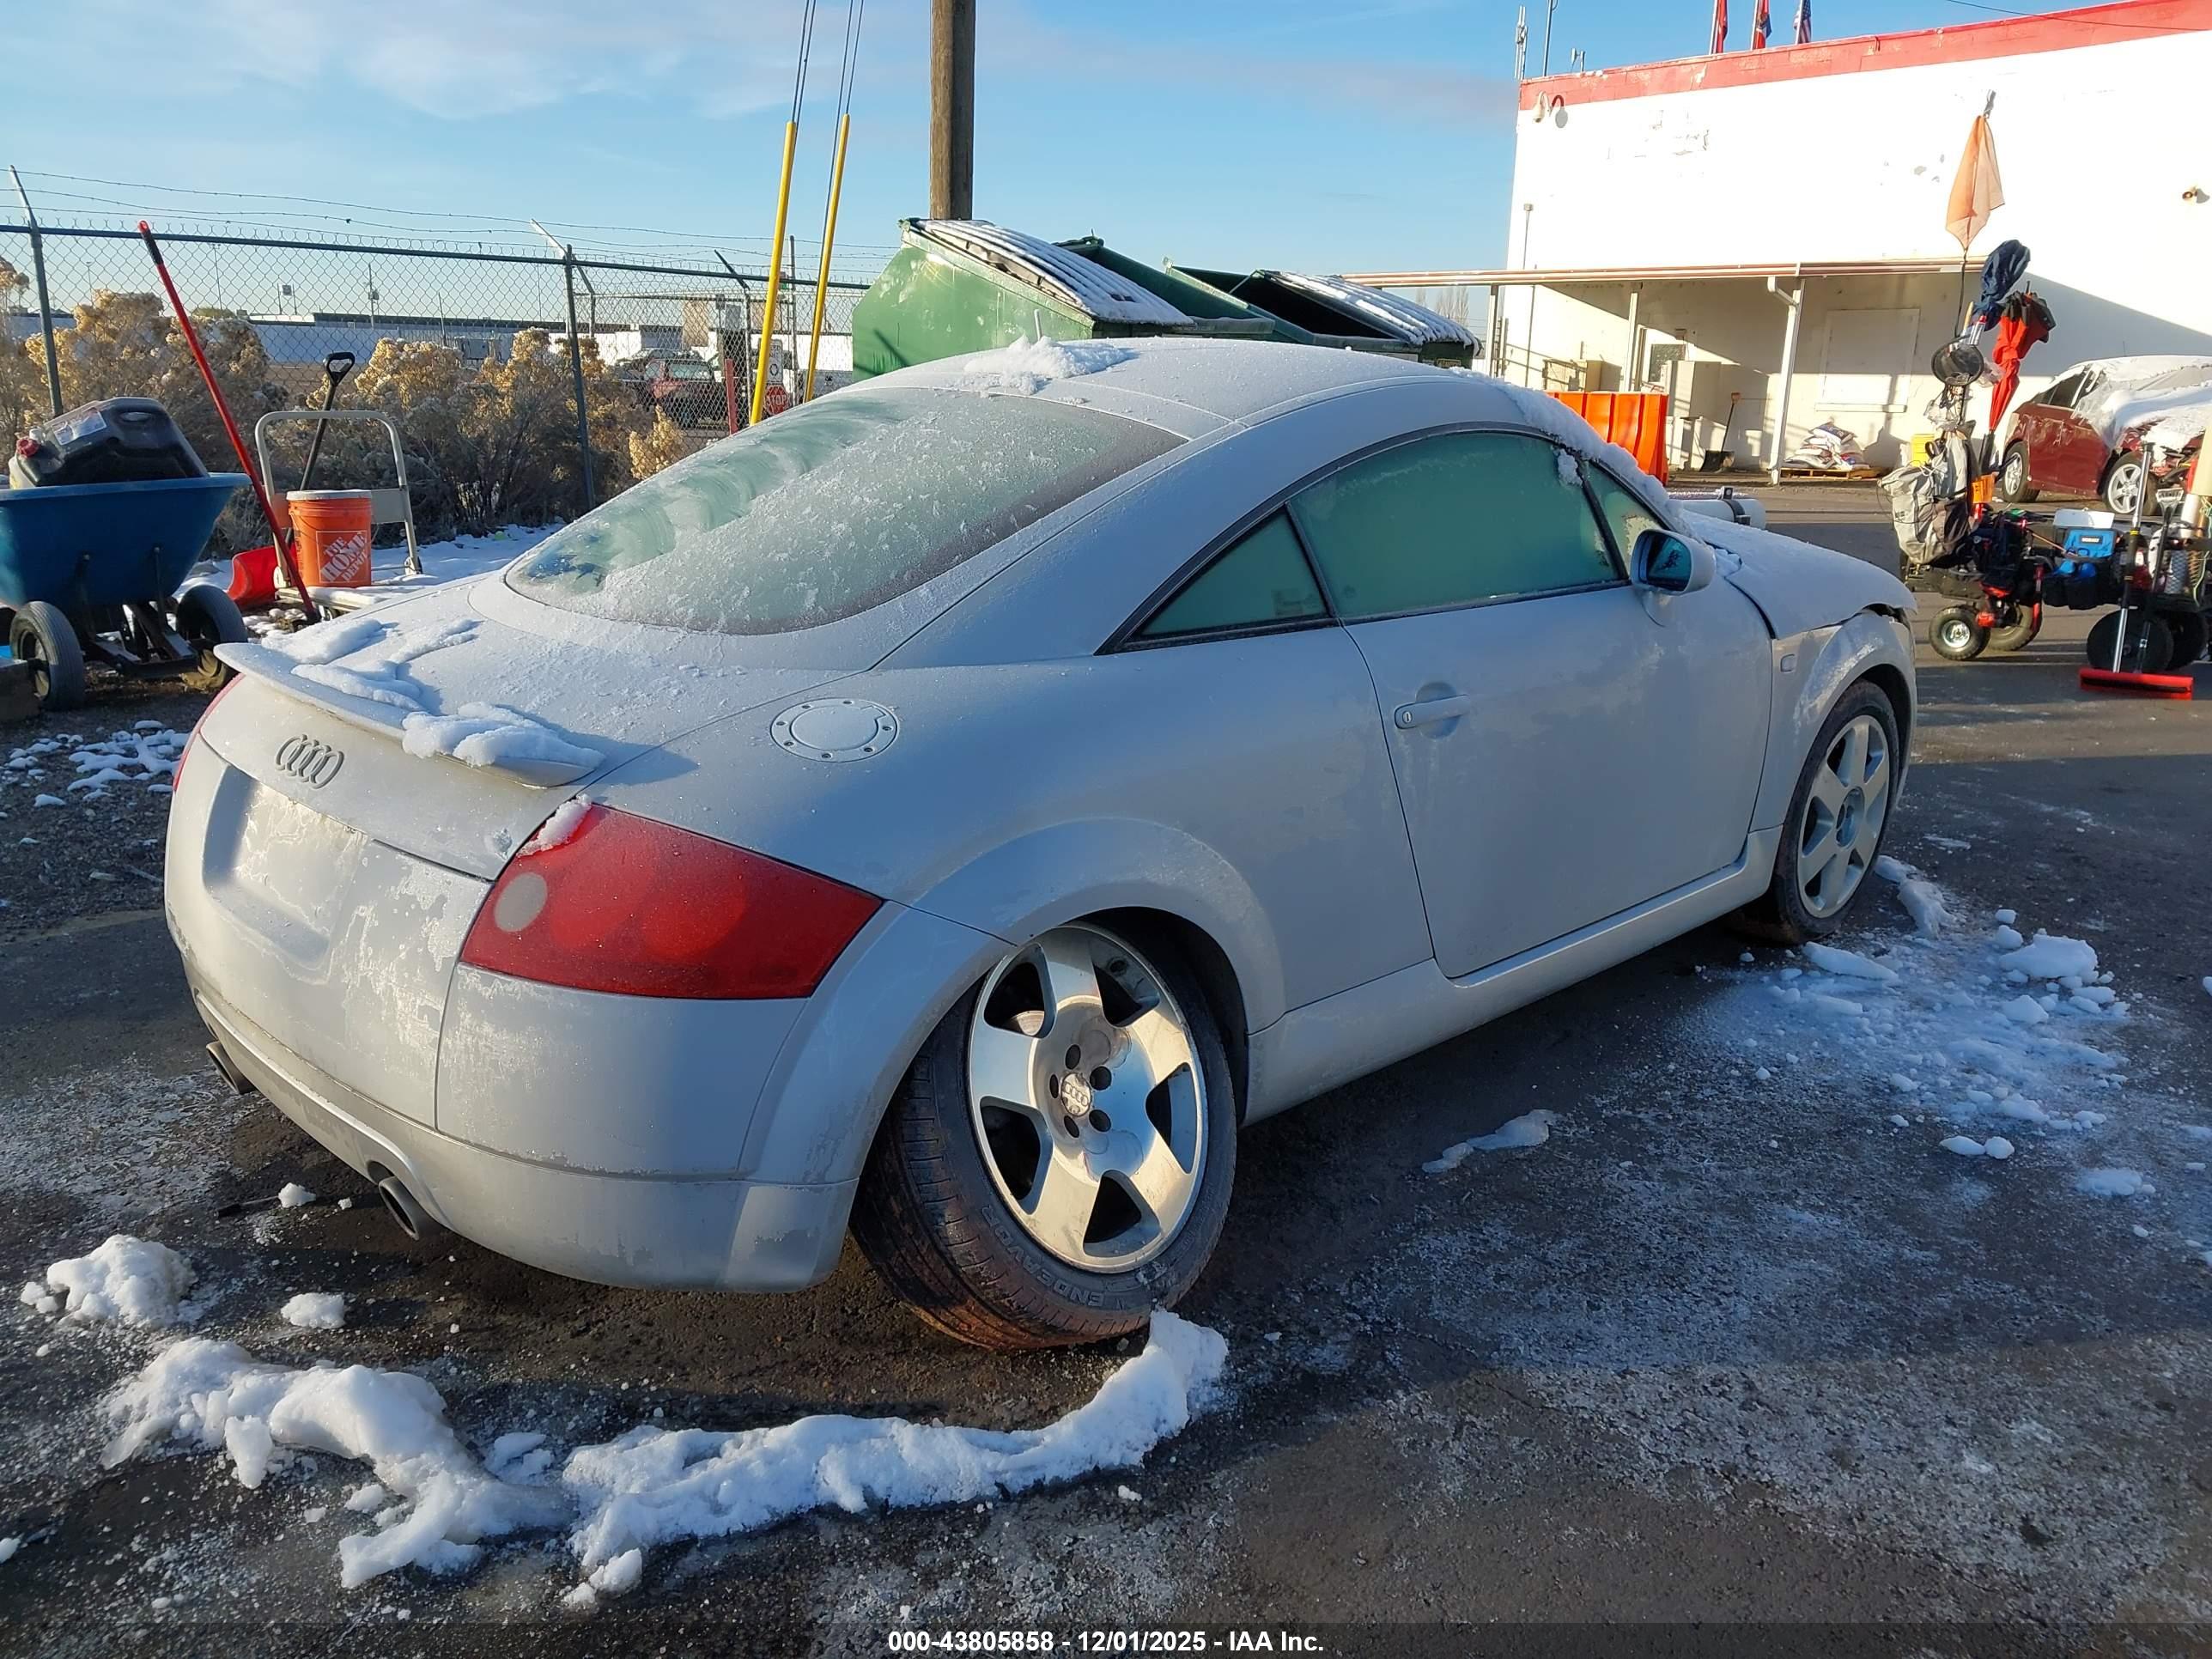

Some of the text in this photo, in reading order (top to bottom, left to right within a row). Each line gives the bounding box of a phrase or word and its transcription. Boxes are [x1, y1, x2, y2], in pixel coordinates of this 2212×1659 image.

[767, 394, 787, 406] STOP
[320, 532, 366, 582] HOME
[324, 537, 345, 556] THE
[341, 551, 367, 582] DEPOT
[981, 1204, 1104, 1307] ENDEAVOR
